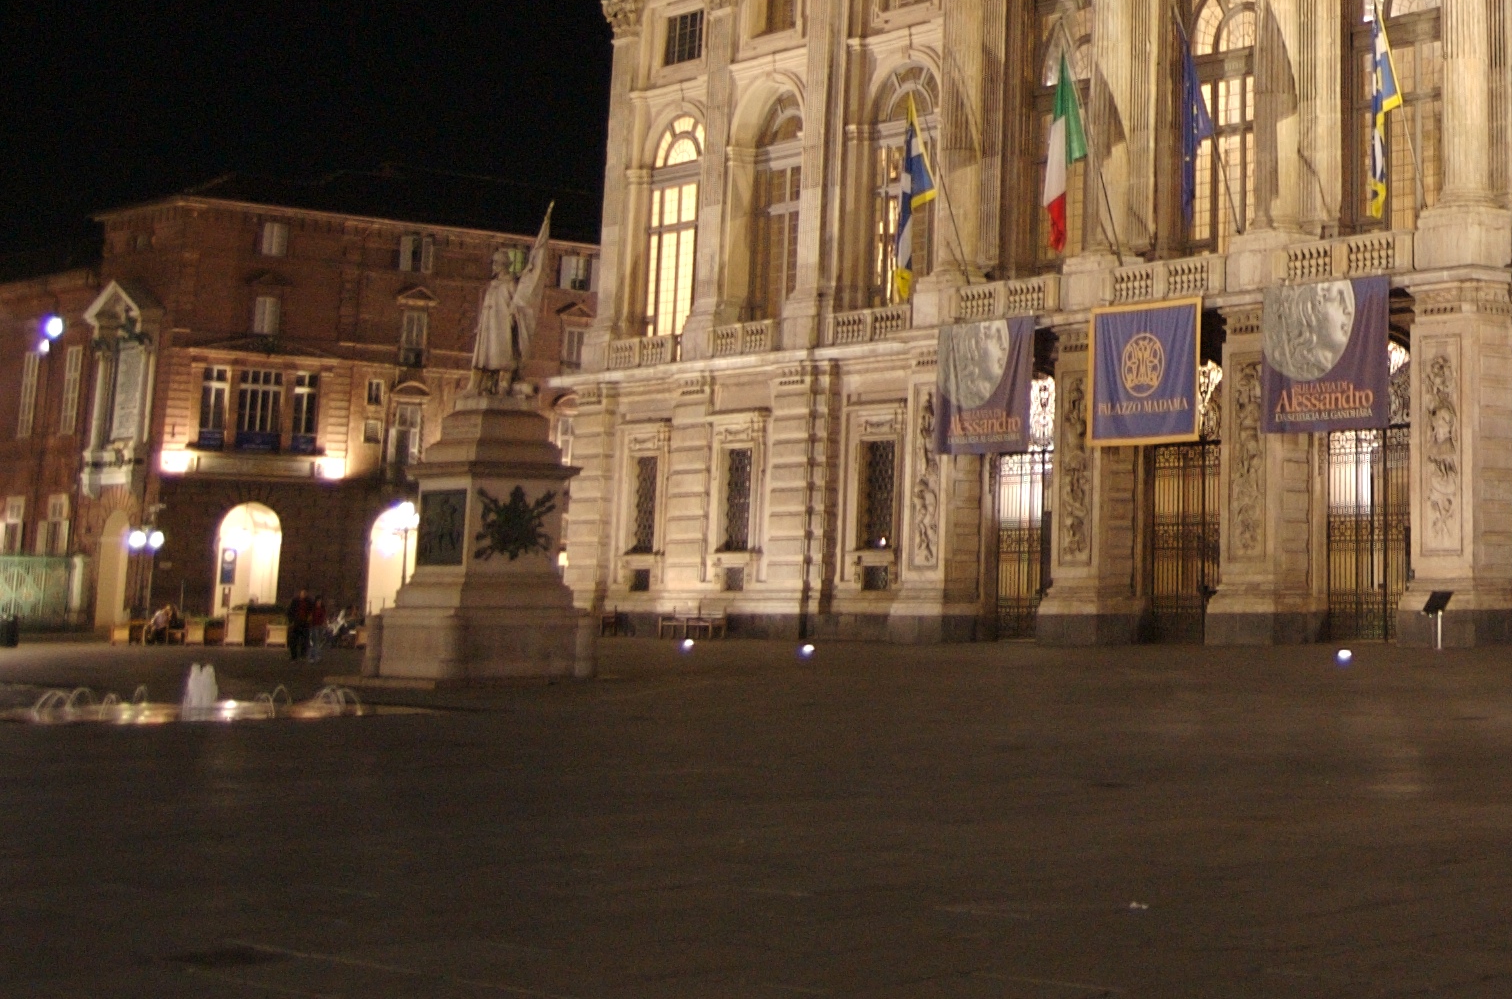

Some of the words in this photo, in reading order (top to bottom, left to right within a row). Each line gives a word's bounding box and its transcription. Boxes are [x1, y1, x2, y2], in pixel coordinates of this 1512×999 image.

[1098, 401, 1141, 416] PALAZZO
[1143, 397, 1189, 412] MADAMA
[1275, 383, 1374, 412] Alessandro
